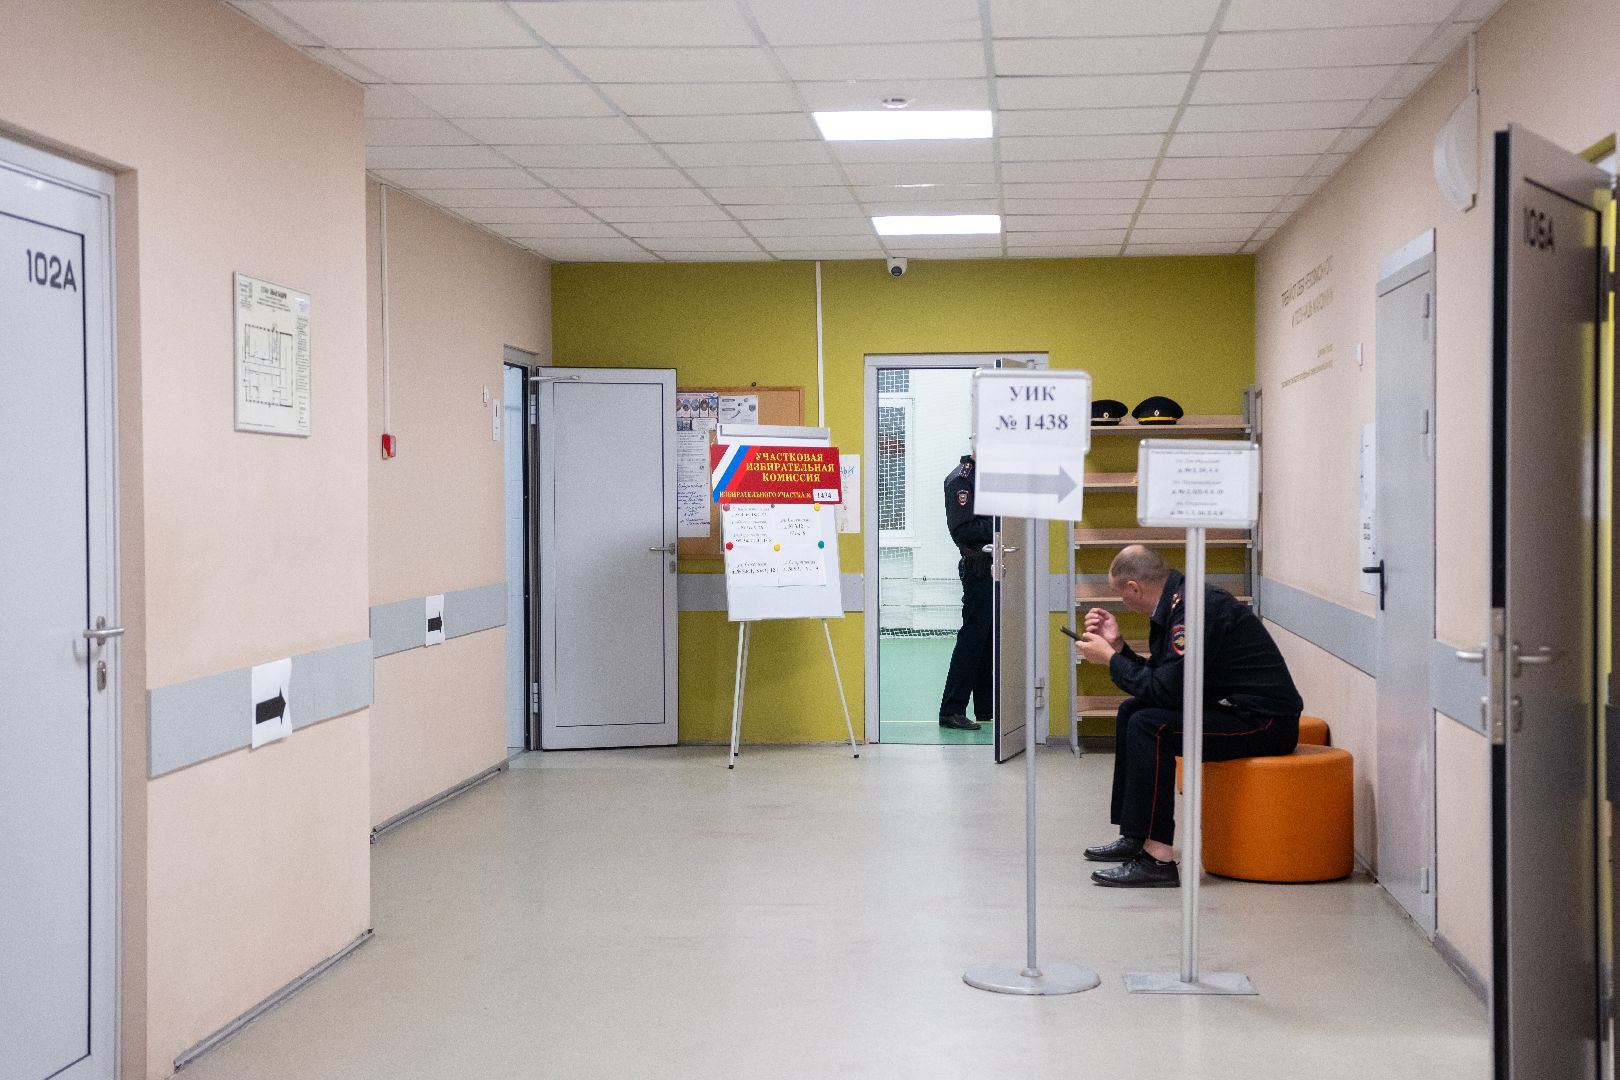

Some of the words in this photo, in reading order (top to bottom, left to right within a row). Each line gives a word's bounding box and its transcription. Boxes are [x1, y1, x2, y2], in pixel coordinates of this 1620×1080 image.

[26, 249, 77, 293] 102А
[1009, 385, 1056, 402] УИК
[995, 414, 1018, 431] №
[1025, 414, 1069, 431] 1438
[755, 452, 823, 462] УЧАСТКОВАЯ
[746, 463, 835, 472] ИЗБИРАТЕЛЬНАЯ
[762, 473, 820, 482] КОМИССИЯ
[719, 491, 777, 499] ИЗБИРАТЕЛЬНОГО
[777, 491, 805, 499] УЧАСТКА
